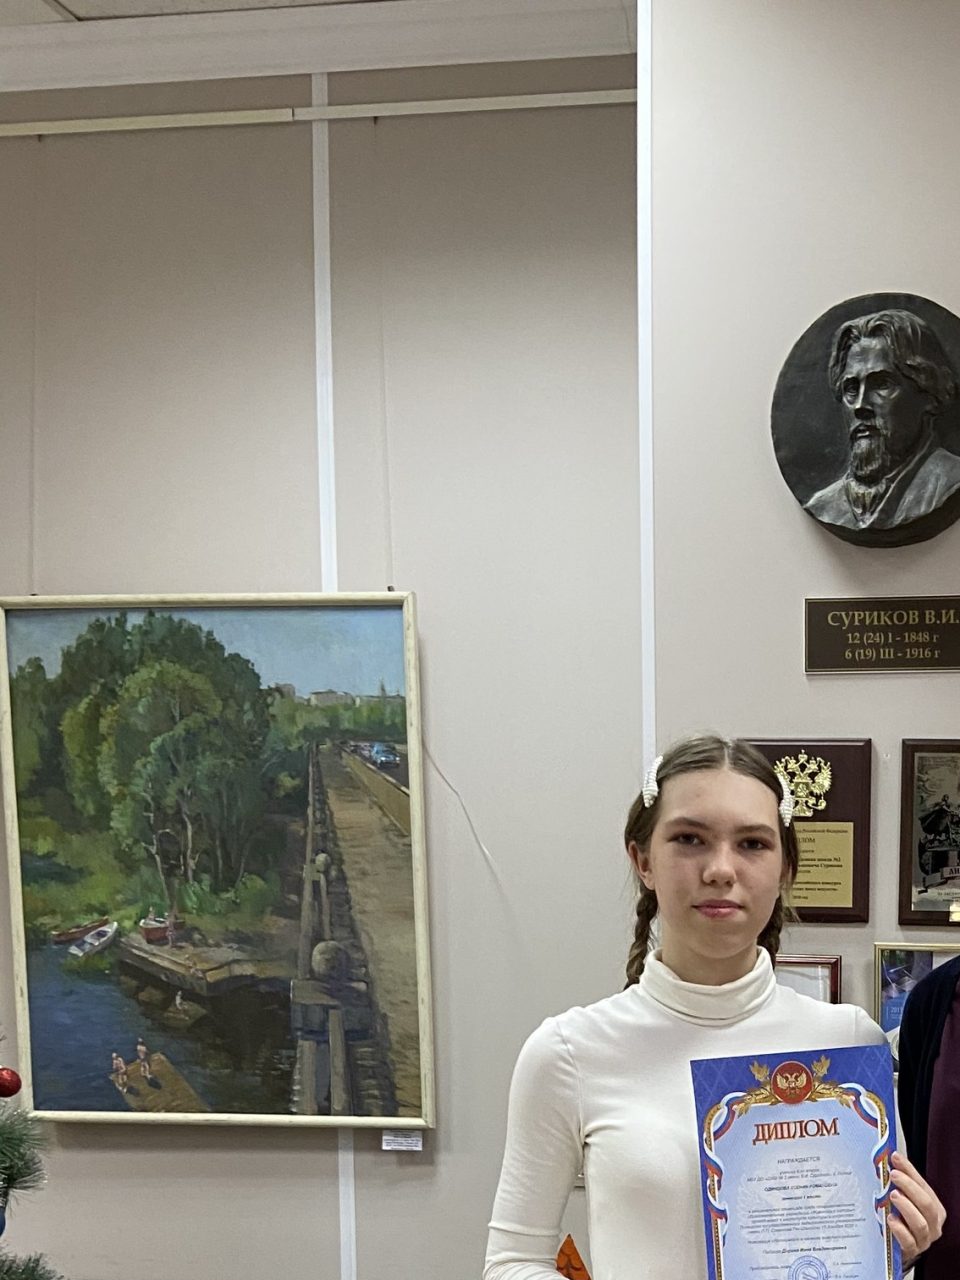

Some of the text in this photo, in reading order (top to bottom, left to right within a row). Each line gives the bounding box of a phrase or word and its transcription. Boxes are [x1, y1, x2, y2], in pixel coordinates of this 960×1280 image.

[827, 609, 960, 629] СУРИКОВ В.И.
[847, 633, 860, 643] 12
[863, 632, 884, 645] (24)
[904, 632, 930, 643] 1848
[845, 649, 852, 659] 6
[855, 648, 876, 661] (19)
[906, 648, 931, 659] 1916
[752, 1117, 840, 1145] ДИПЛОМ
